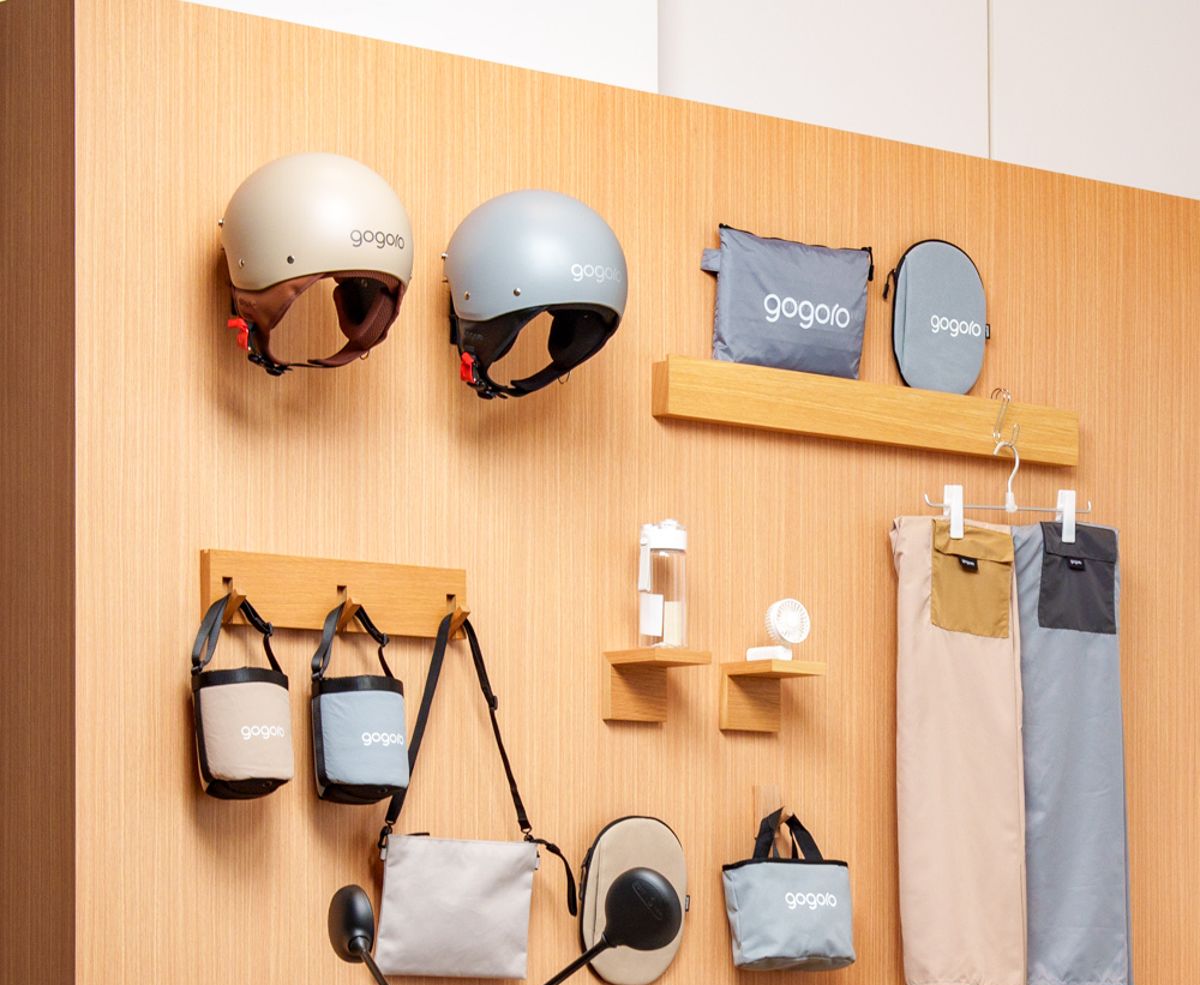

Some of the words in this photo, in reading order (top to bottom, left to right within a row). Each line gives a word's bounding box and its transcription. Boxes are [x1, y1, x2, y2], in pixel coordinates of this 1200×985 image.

[350, 229, 405, 250] gogoro
[571, 264, 622, 283] gogoro
[763, 293, 850, 329] gogoro
[930, 314, 981, 337] gogoro
[240, 725, 285, 741] gogoro
[361, 731, 404, 747] gogoro
[784, 892, 838, 911] gogoro
